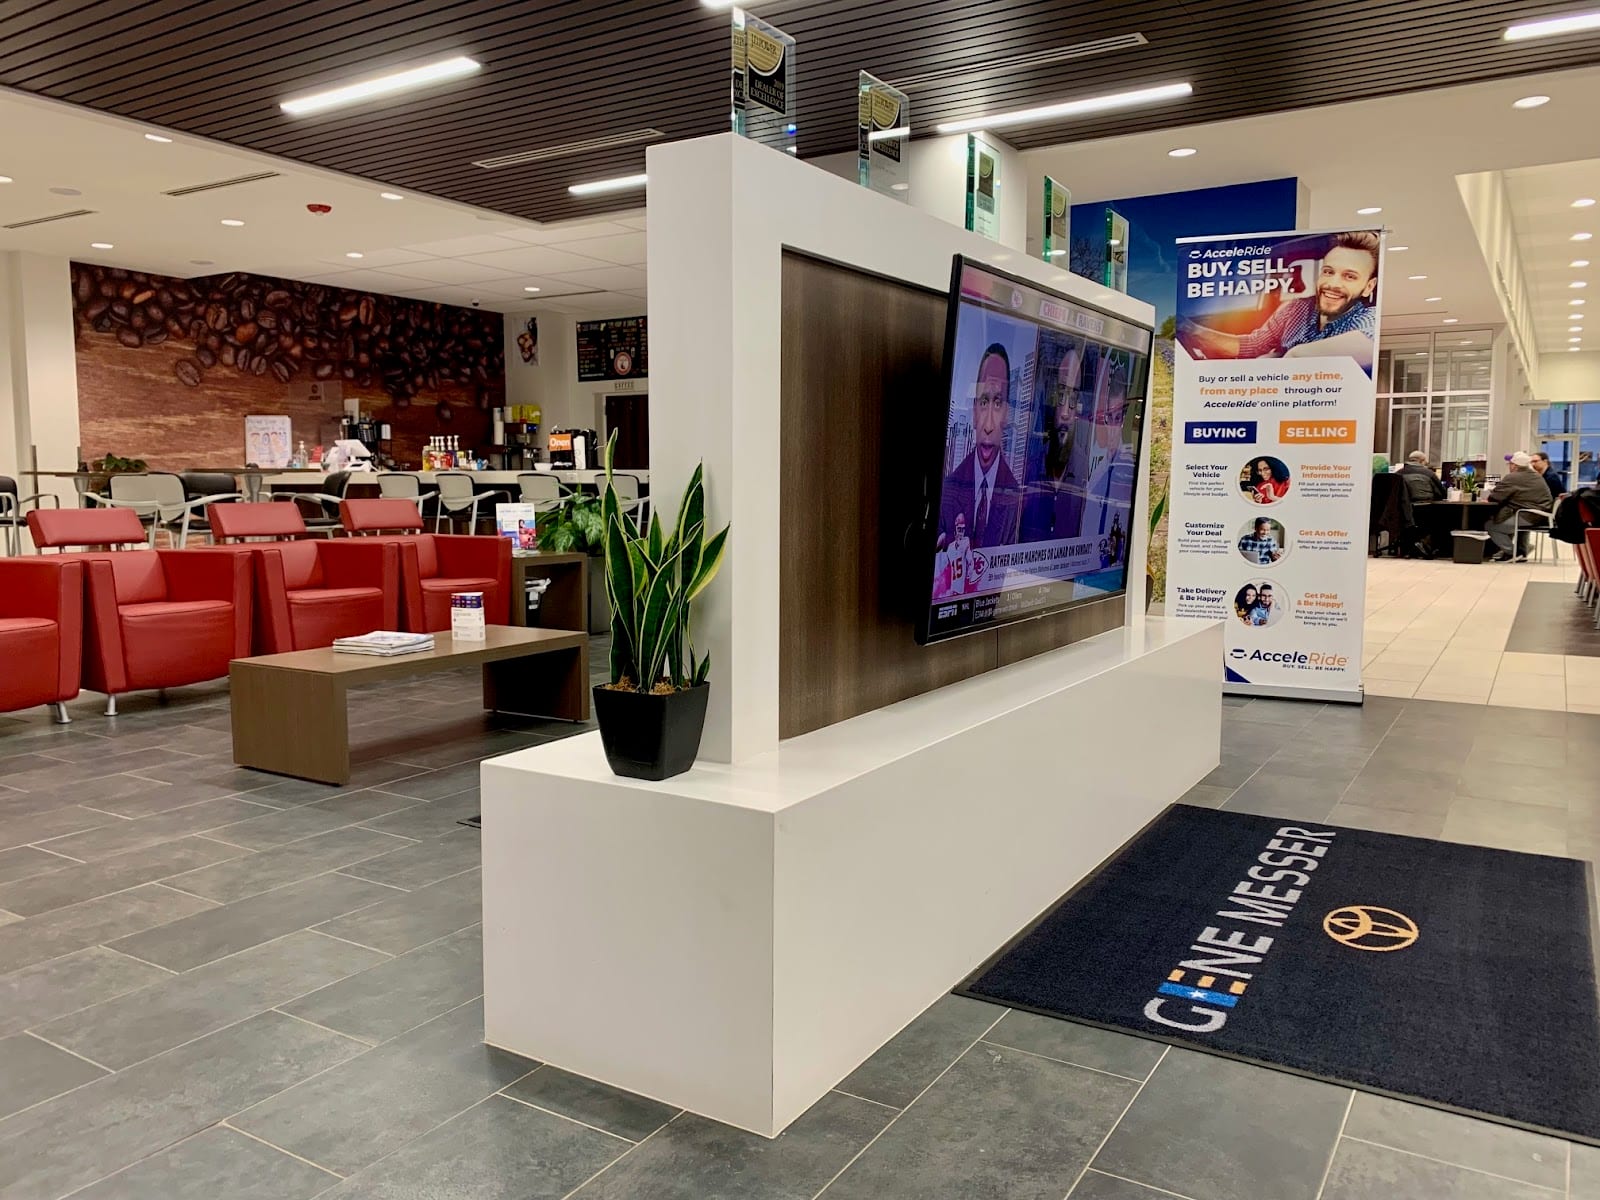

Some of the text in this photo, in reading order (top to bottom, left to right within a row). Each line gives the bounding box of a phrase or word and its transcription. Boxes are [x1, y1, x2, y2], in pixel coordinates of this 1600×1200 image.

[755, 80, 776, 96] DEALER
[776, 91, 784, 99] OF
[750, 87, 784, 110] EXCELLENCE
[1203, 245, 1272, 258] AcceleRide
[1188, 258, 1295, 279] BUY. SELL.
[1187, 278, 1295, 298] BE HAPPY.
[1199, 375, 1216, 384] Buy
[1230, 374, 1246, 382] sell
[1256, 373, 1290, 382] vehicle
[1292, 374, 1312, 383] any
[1200, 387, 1227, 395] from
[1228, 388, 1248, 397] any
[1249, 387, 1279, 396] place
[1284, 386, 1323, 395] through
[1260, 400, 1290, 408] online
[1292, 399, 1337, 408] platform!
[1192, 427, 1247, 438] BUYING
[1286, 427, 1348, 438] SELLING
[551, 437, 571, 448] Open
[989, 553, 1010, 569] RATHER
[1011, 552, 1024, 566] HAVE
[1024, 549, 1047, 564] MAHOMES
[1047, 547, 1054, 560] OR
[1054, 545, 1068, 559] LAMAR
[1069, 545, 1075, 557] ON
[952, 557, 963, 580] 15
[1195, 587, 1227, 596] Delivery
[1196, 595, 1223, 603] Happy!
[938, 604, 958, 619] ESPN
[1249, 649, 1348, 666] AcceleRide
[1144, 826, 1336, 1033] GENE MESSER
